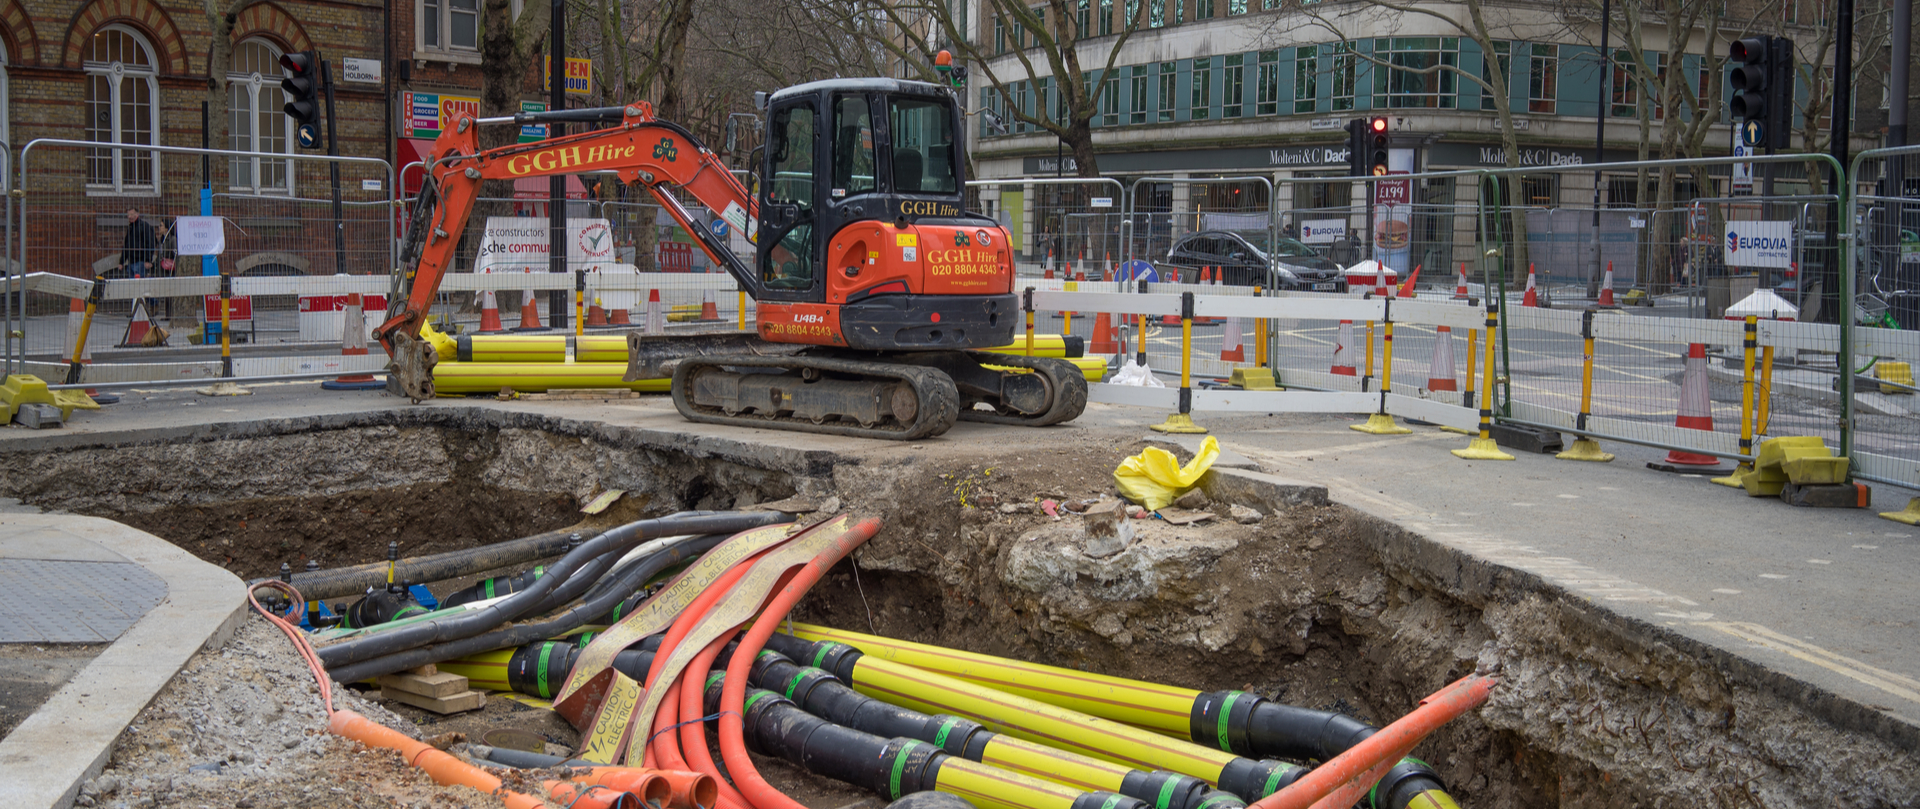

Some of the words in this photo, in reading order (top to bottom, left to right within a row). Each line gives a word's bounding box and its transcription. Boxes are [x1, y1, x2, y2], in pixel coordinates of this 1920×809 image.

[345, 72, 374, 80] HOLBORN
[405, 118, 412, 129] 24
[508, 146, 582, 175] GGH
[586, 144, 635, 164] Hire
[1270, 148, 1319, 164] Molteni&C
[1479, 147, 1545, 165] Molti&C
[1551, 152, 1582, 165] Dada
[1038, 158, 1067, 171] MolteniC
[1379, 187, 1404, 198] £1.99
[900, 201, 937, 215] GGH
[940, 205, 959, 216] Hire
[496, 228, 544, 237] constructors
[1312, 227, 1343, 235] EUROVIA
[1740, 237, 1787, 250] EUROVIA
[927, 249, 972, 264] GGH
[977, 252, 997, 263] Hire
[932, 265, 951, 275] 020
[954, 264, 977, 275] 8804
[979, 264, 997, 275] 4343
[810, 326, 831, 336] 4343
[660, 573, 696, 605] CAUTION
[702, 540, 740, 568] CAUTION
[699, 563, 732, 589] CABLE
[722, 546, 750, 568] BELOW
[596, 686, 623, 735] CAUTION
[608, 700, 632, 746] ELECTRIC
